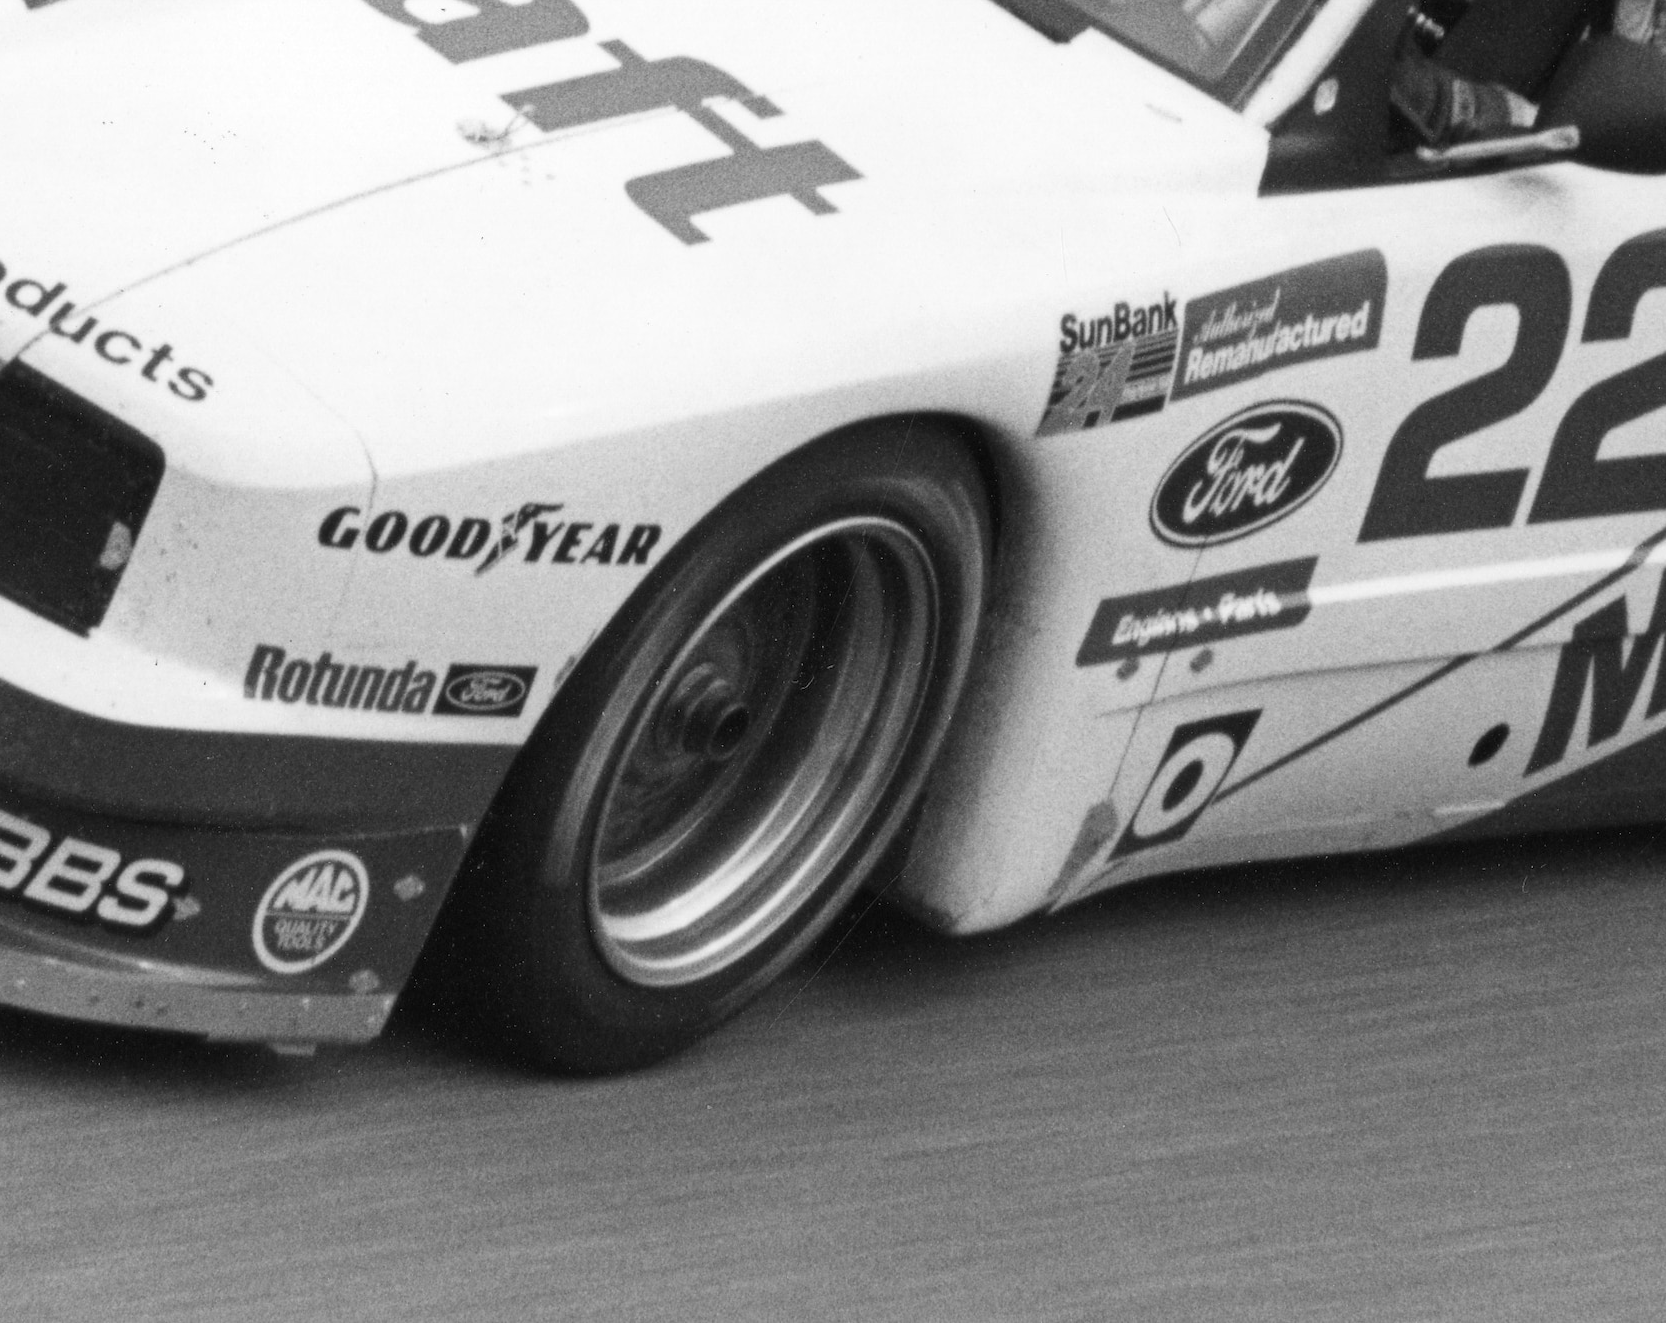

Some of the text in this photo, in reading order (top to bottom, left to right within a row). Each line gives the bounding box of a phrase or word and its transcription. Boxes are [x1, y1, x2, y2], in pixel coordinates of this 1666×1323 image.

[1057, 290, 1178, 355] SunBank
[1183, 299, 1371, 384] Remanufactured
[1181, 422, 1308, 525] Ford
[317, 503, 663, 576] GOODYEAR
[1112, 588, 1282, 647] Engines Parts
[242, 644, 513, 715] Rotunda Ford
[273, 864, 356, 913] MAC
